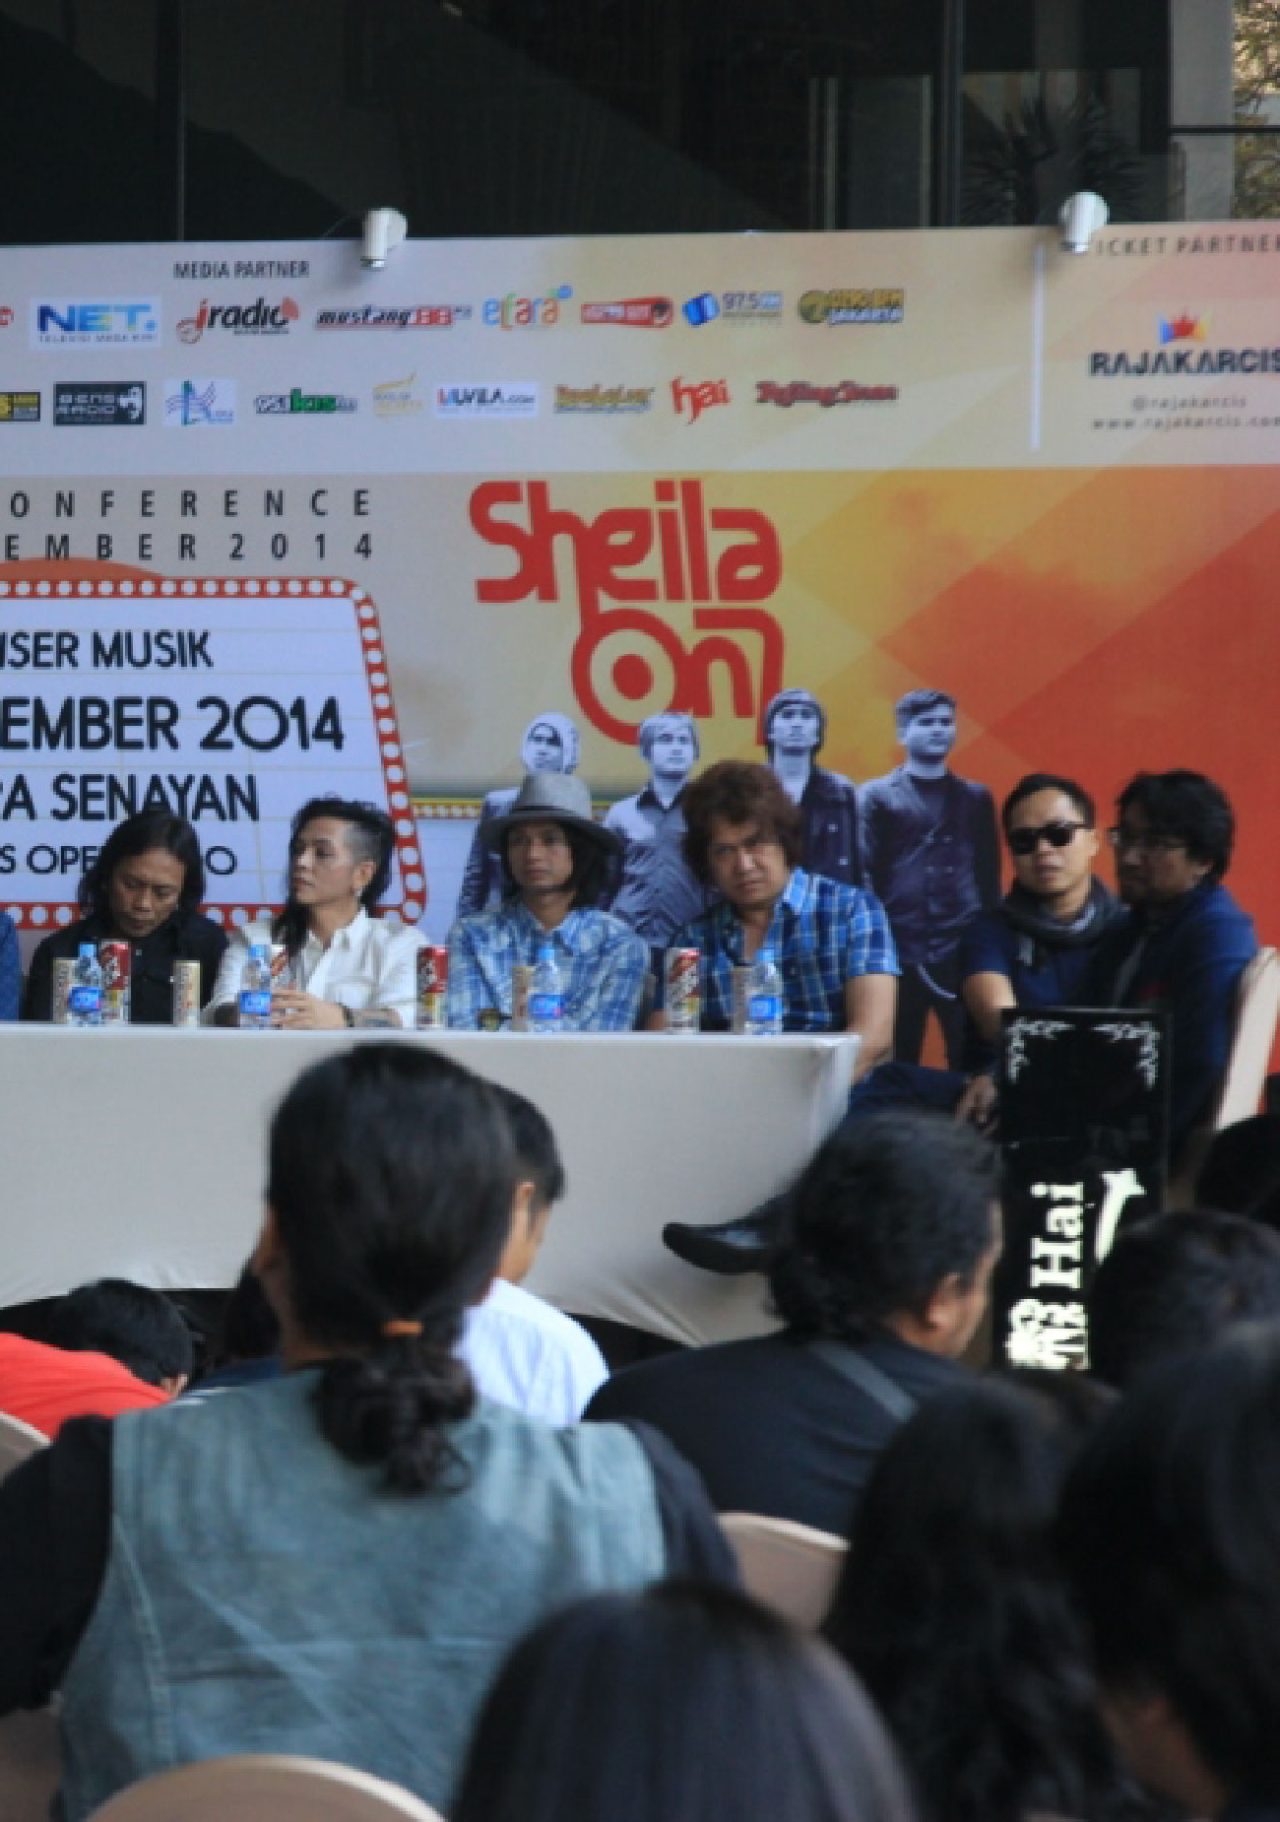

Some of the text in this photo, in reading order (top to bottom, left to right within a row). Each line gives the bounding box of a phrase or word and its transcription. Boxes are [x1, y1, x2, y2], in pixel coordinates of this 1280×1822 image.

[1096, 237, 1167, 256] ICKET
[174, 260, 310, 279] MEDIA PARTNER
[227, 532, 374, 560] 2014
[468, 479, 783, 603] Sheila
[91, 628, 215, 669] MUSIK
[198, 694, 346, 752] 2014
[50, 772, 261, 822] SENAYAN
[1028, 1179, 1085, 1290] Hai
